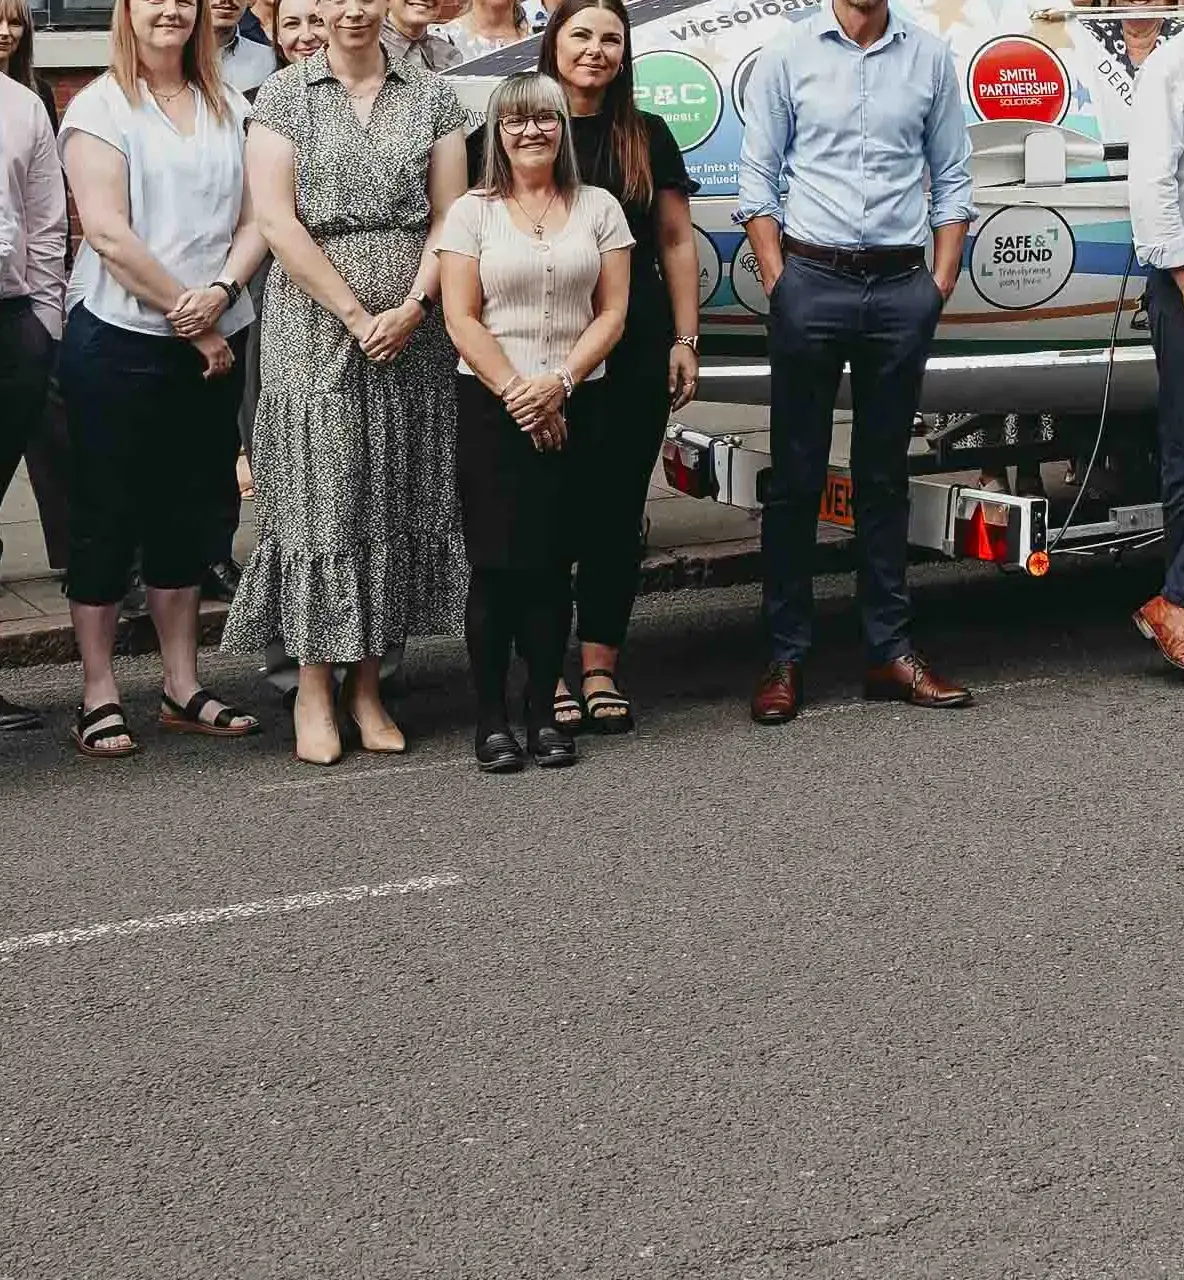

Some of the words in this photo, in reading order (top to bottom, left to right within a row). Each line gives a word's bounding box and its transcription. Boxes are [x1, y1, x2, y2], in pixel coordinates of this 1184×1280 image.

[999, 68, 1037, 82] SMITH
[979, 81, 1059, 97] PARTNERSHIP
[999, 97, 1043, 107] SOLICITORS
[700, 173, 737, 185] valued
[994, 235, 1032, 250] SAFE
[1034, 234, 1046, 248] &
[993, 248, 1053, 264] SOUND
